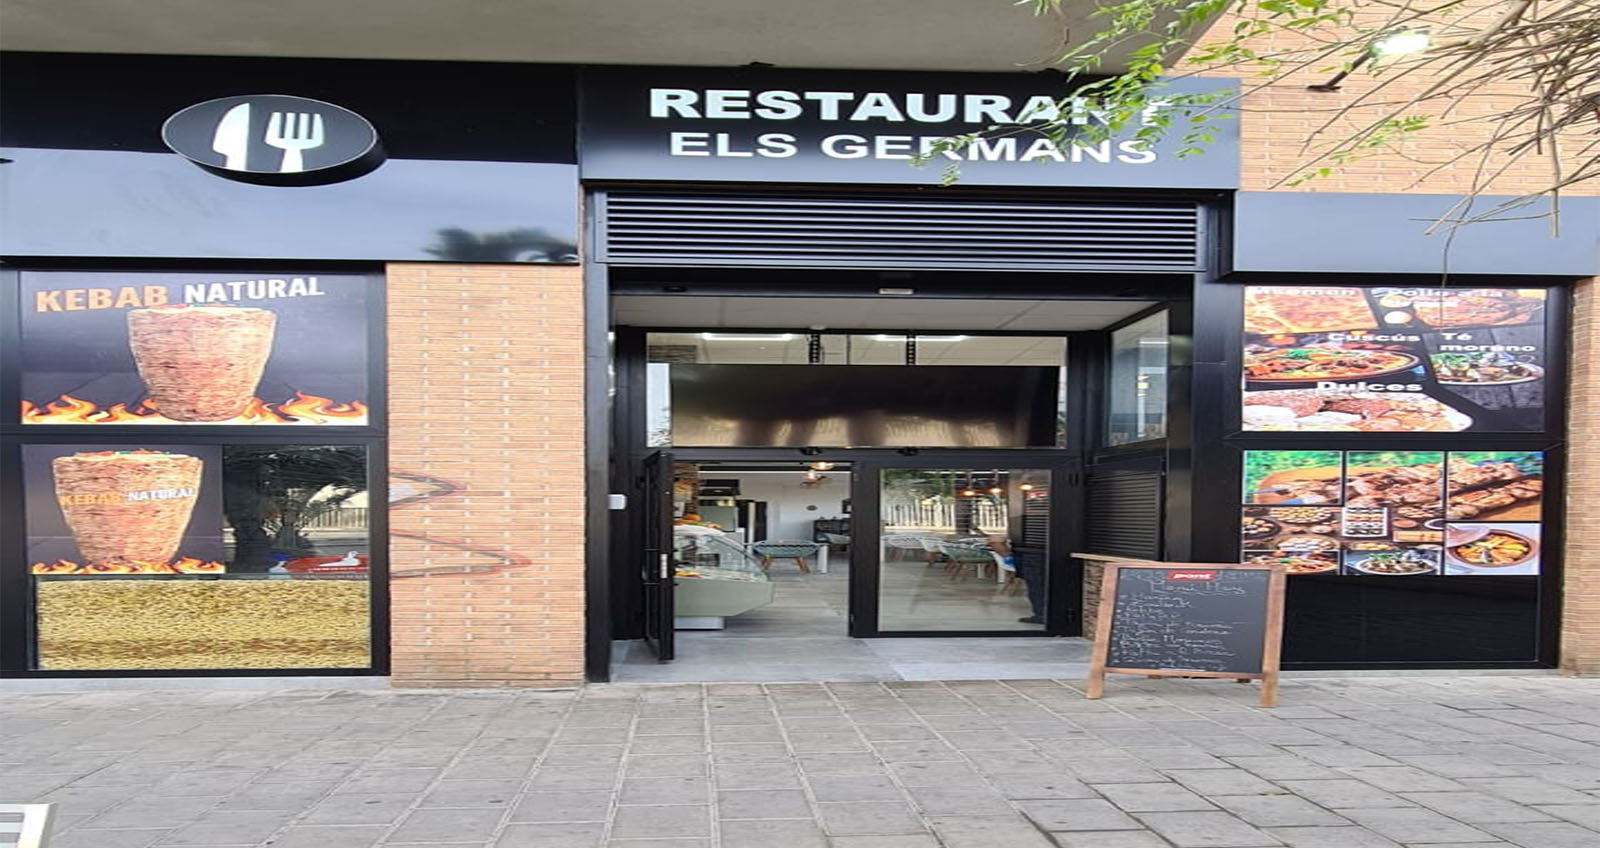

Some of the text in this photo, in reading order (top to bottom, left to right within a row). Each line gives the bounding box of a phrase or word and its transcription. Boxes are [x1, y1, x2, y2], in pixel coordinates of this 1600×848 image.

[670, 132, 1157, 164] ELS GERMANS
[36, 276, 325, 312] KEBAB NATURAL
[1388, 288, 1449, 297] Pollo
[1328, 332, 1421, 342] Cuscús
[1441, 332, 1473, 341] Té
[1317, 381, 1423, 391] Dulces
[59, 487, 195, 506] KEBAB NATURAL
